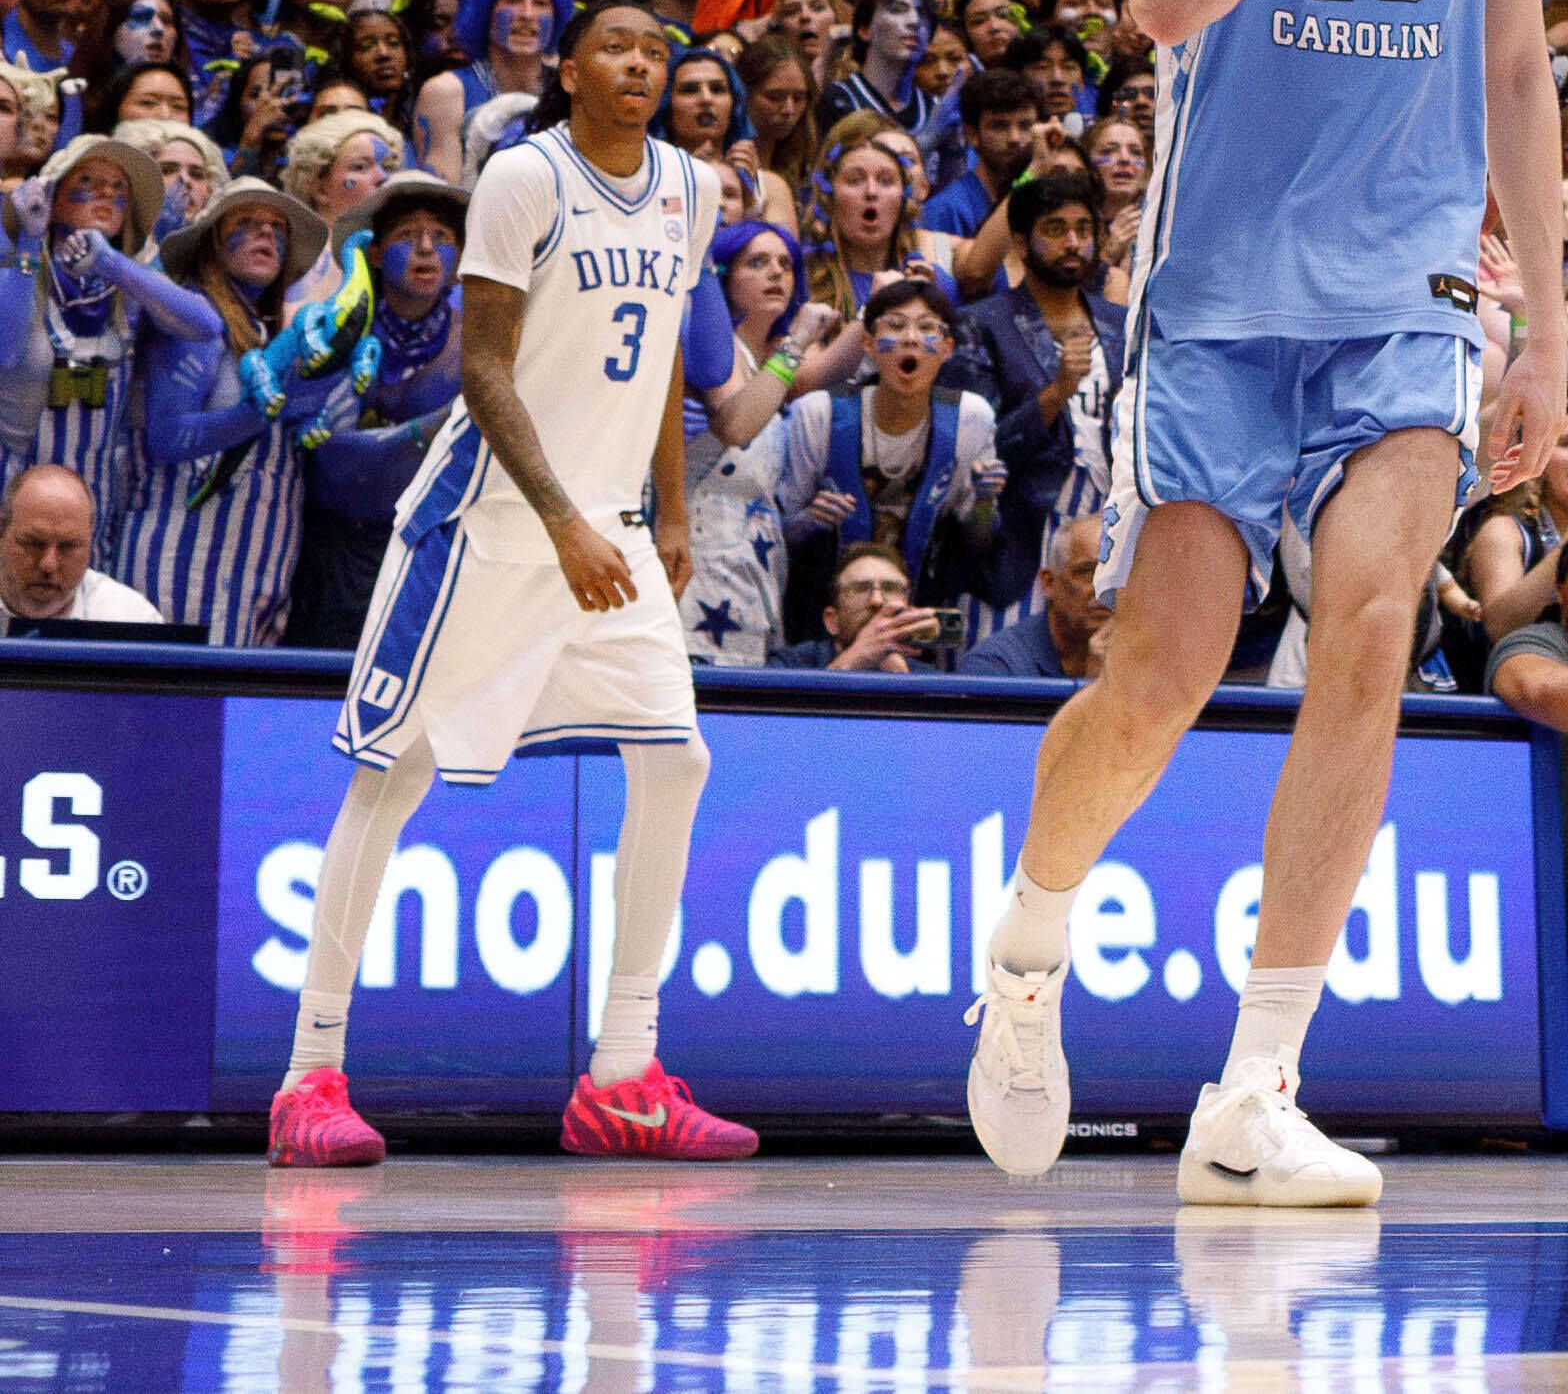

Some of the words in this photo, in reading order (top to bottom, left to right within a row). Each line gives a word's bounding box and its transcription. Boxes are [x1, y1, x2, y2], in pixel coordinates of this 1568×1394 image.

[1271, 10, 1443, 66] CAROLIN
[570, 247, 684, 298] DUKE
[604, 301, 648, 382] 3
[1067, 1122, 1138, 1137] RONICS
